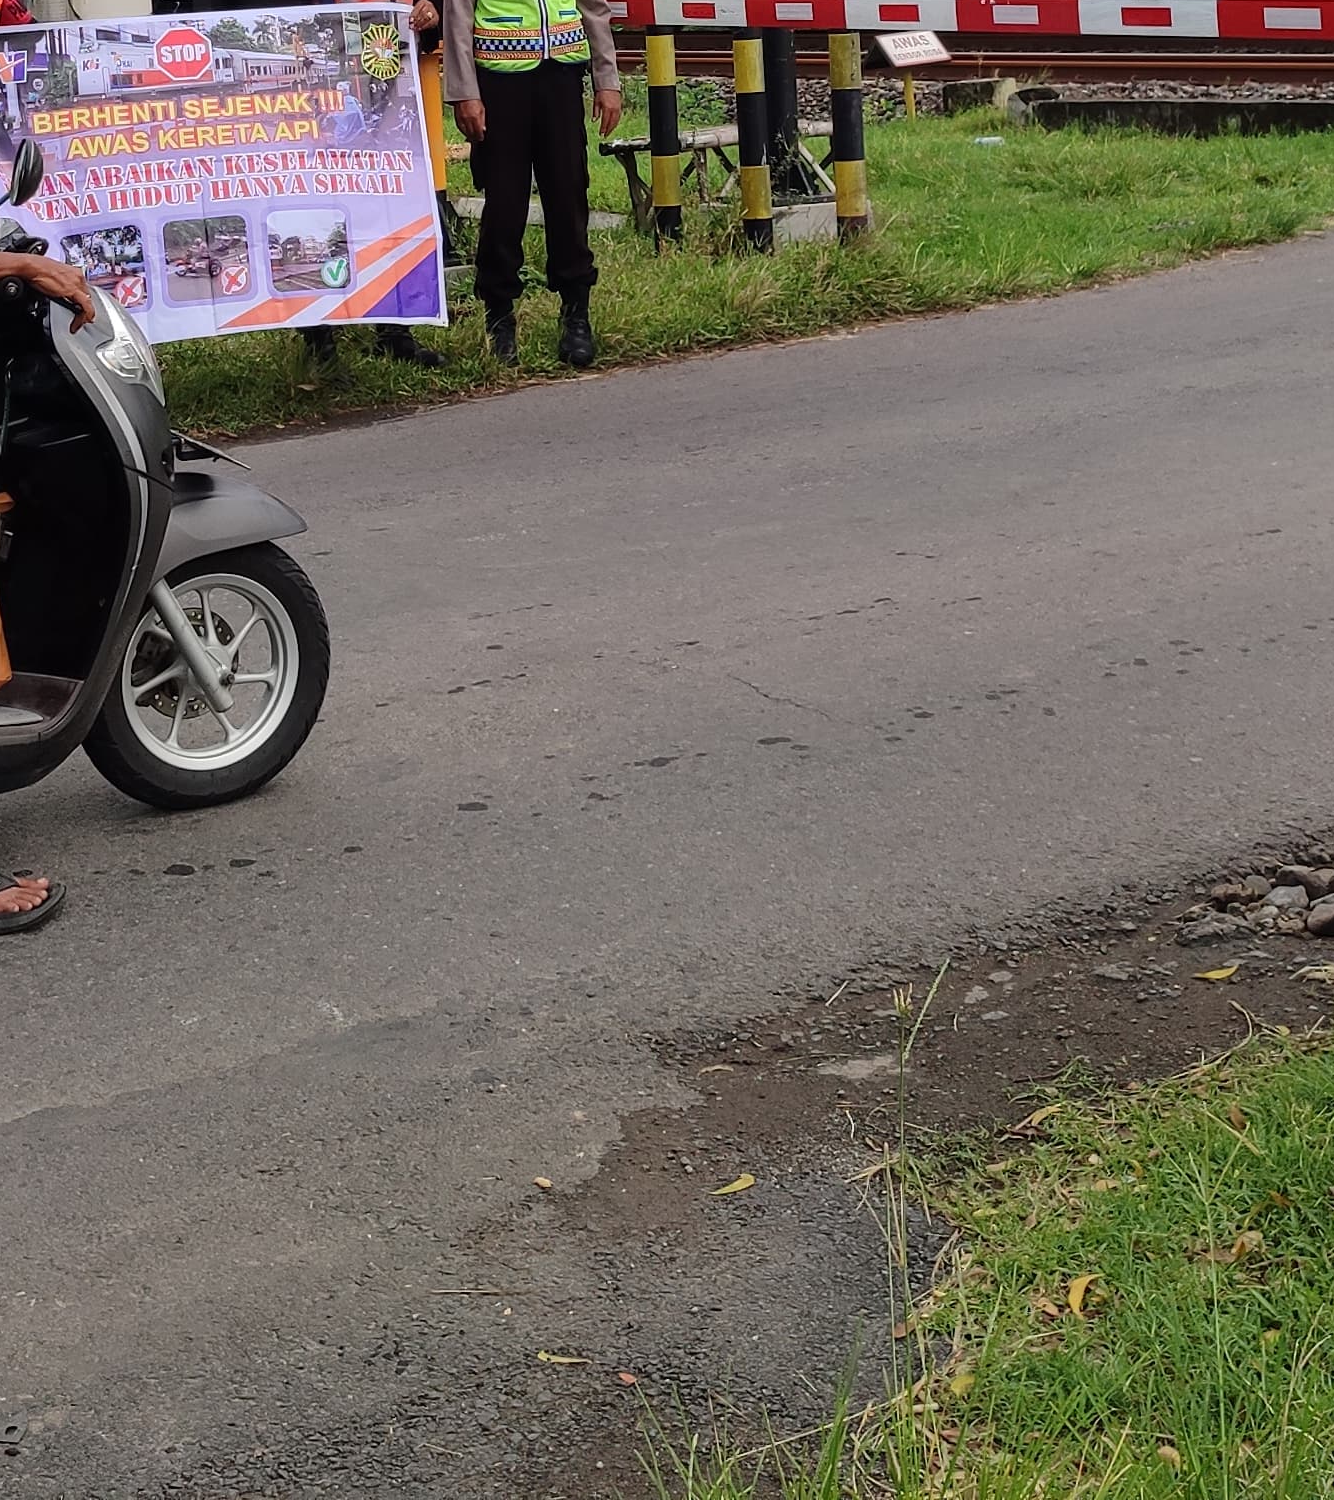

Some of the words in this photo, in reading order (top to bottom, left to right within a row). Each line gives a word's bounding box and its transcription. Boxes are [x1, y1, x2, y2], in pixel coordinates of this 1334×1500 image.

[161, 44, 206, 63] STOP
[892, 35, 930, 50] AWAS
[33, 102, 177, 134] BERHENTI
[185, 92, 312, 119] SEJENAK
[319, 90, 344, 111] !!!
[67, 134, 149, 161] AWAS
[158, 124, 268, 150] KERETA
[274, 120, 320, 142] API
[84, 155, 216, 192] ABAIKAN
[222, 149, 414, 176] KESELAMATAN
[27, 193, 102, 222] RENA
[107, 182, 204, 212] HIDUP
[210, 173, 309, 201] HANYA
[314, 172, 405, 195] SEKALI
